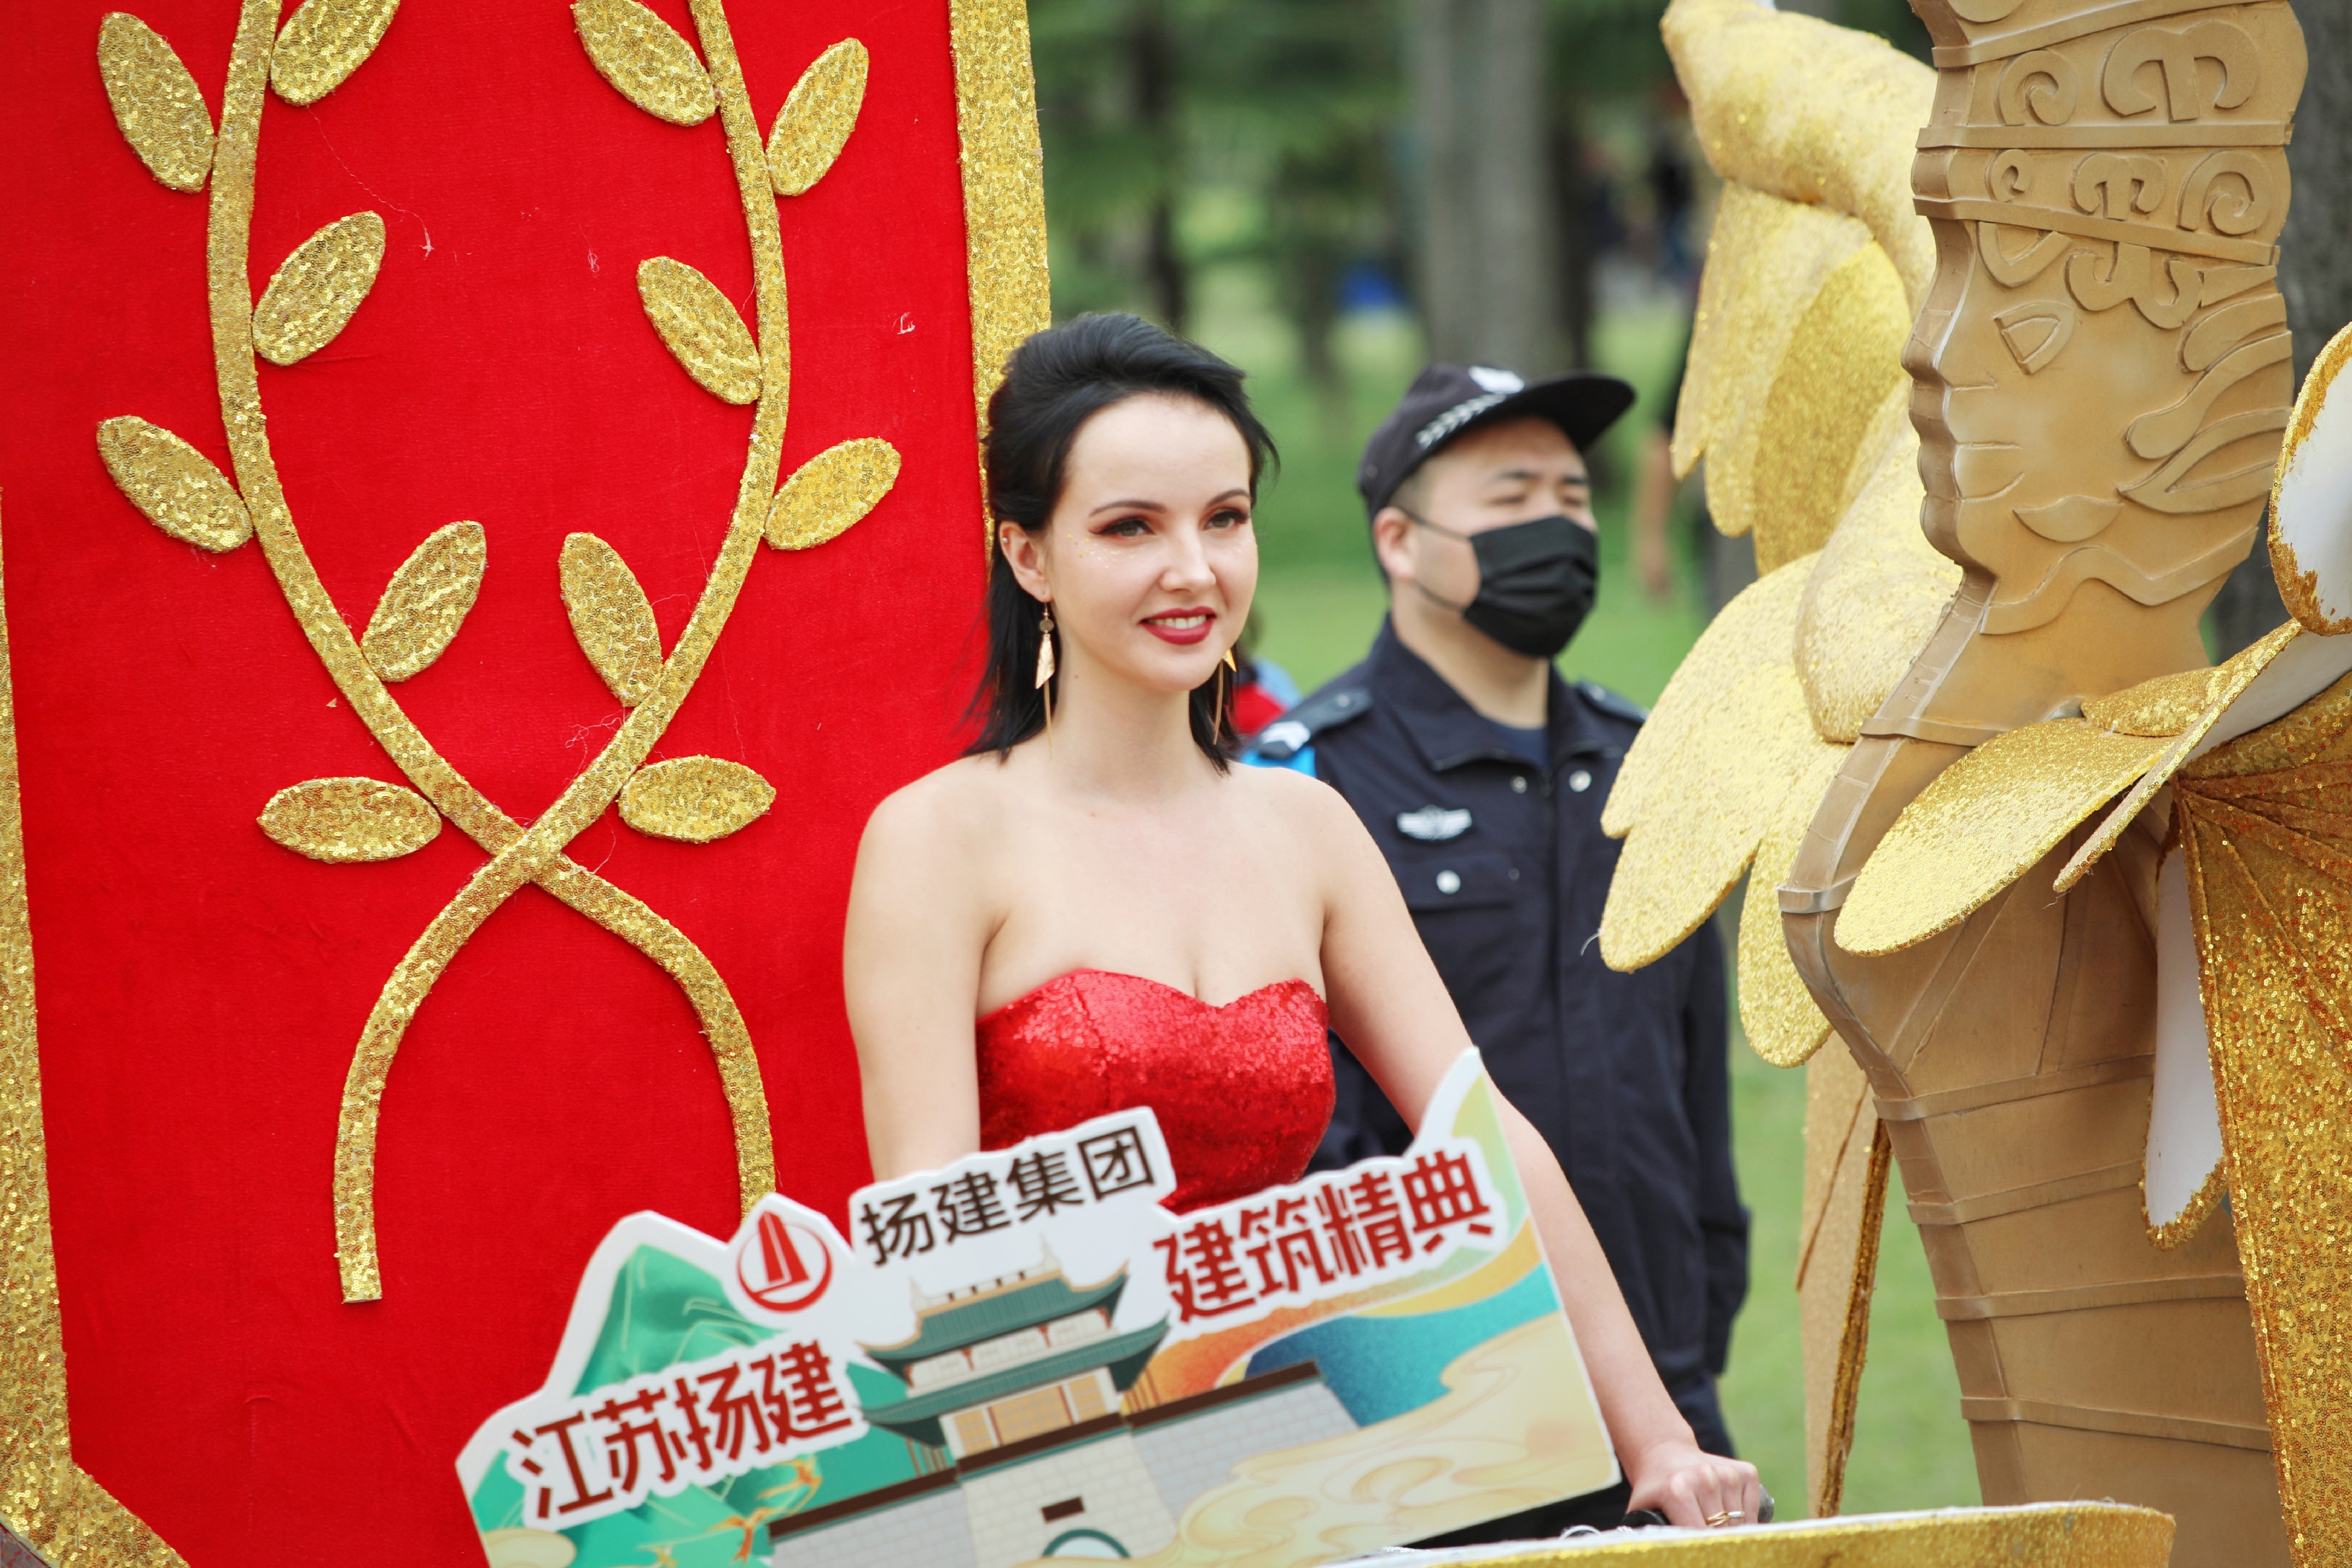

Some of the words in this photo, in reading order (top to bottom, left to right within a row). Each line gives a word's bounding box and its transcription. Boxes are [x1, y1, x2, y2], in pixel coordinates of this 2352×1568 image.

[860, 1126, 1154, 1267] 扬建集团
[1154, 1151, 1494, 1323] 建筑精典
[512, 1340, 853, 1520] 江苏扬建
